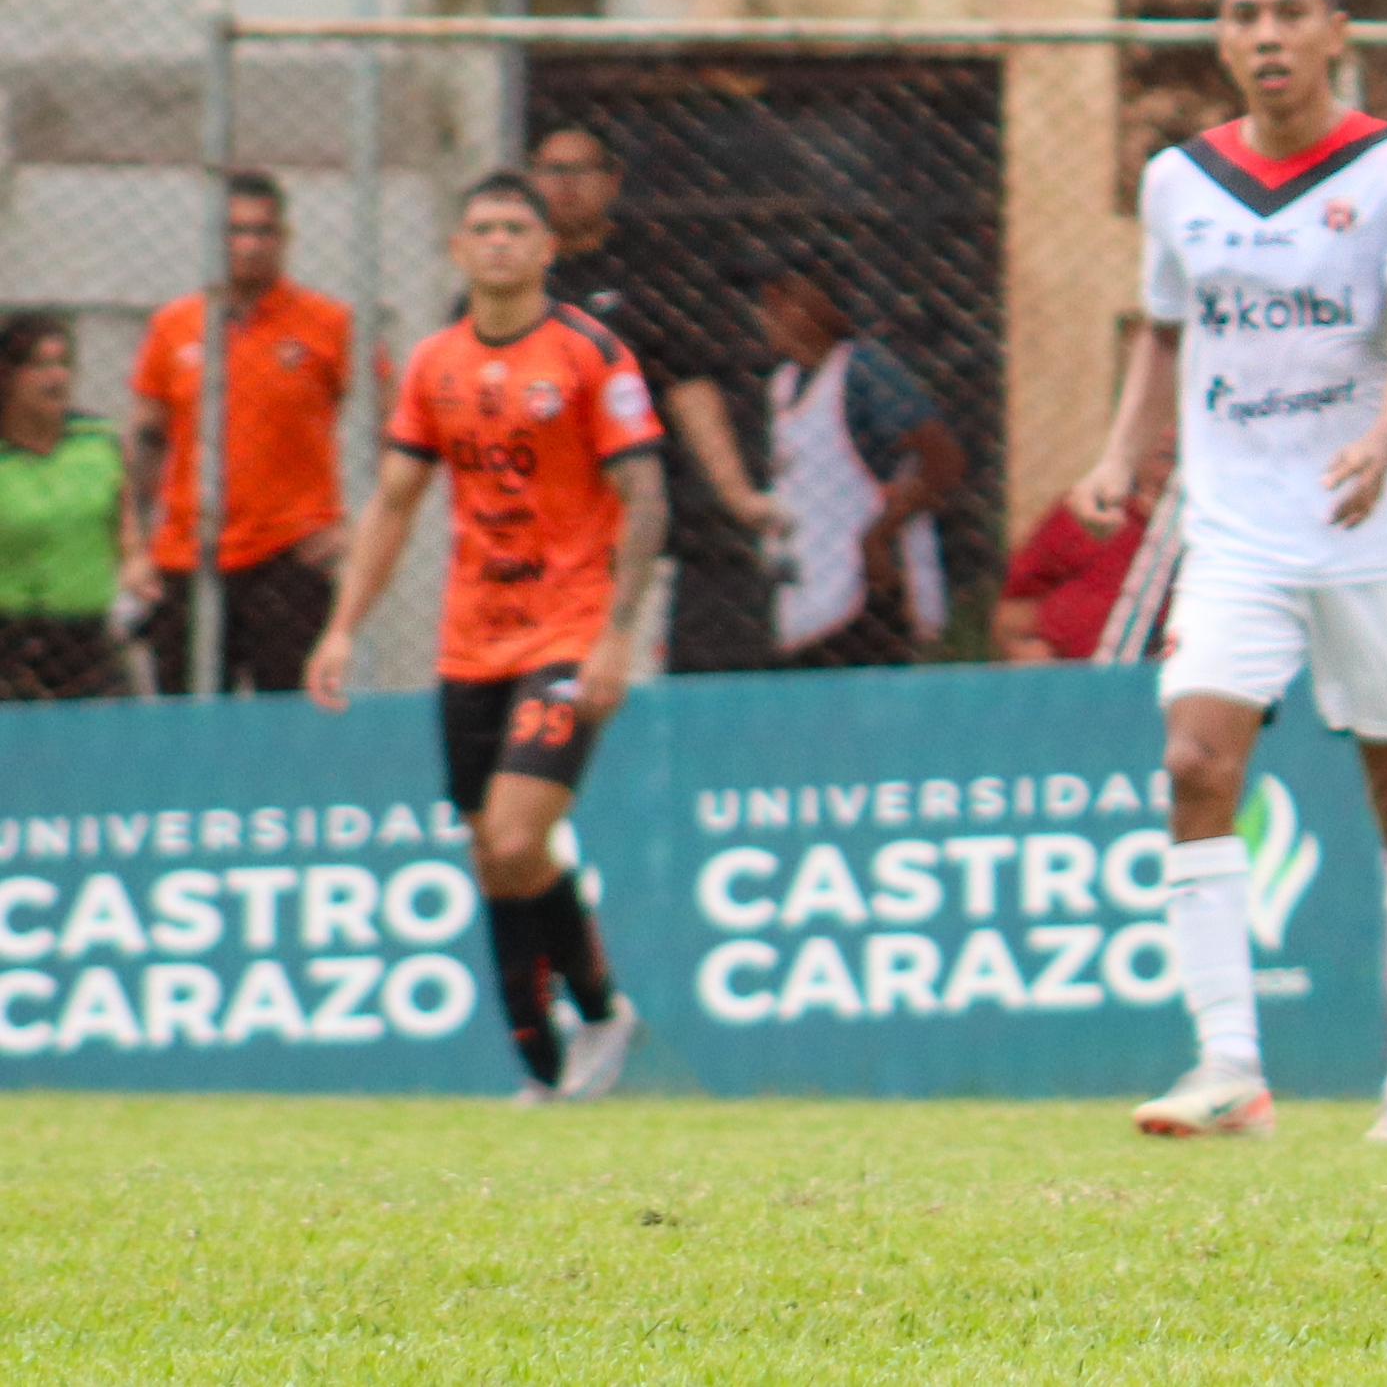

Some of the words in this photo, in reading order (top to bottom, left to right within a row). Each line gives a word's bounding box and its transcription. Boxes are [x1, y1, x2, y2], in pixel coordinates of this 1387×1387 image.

[0, 860, 478, 959] CASTRO
[699, 828, 1172, 929] CASTRO
[0, 952, 477, 1053] CARAZO
[699, 921, 1184, 1021] CARAZO
